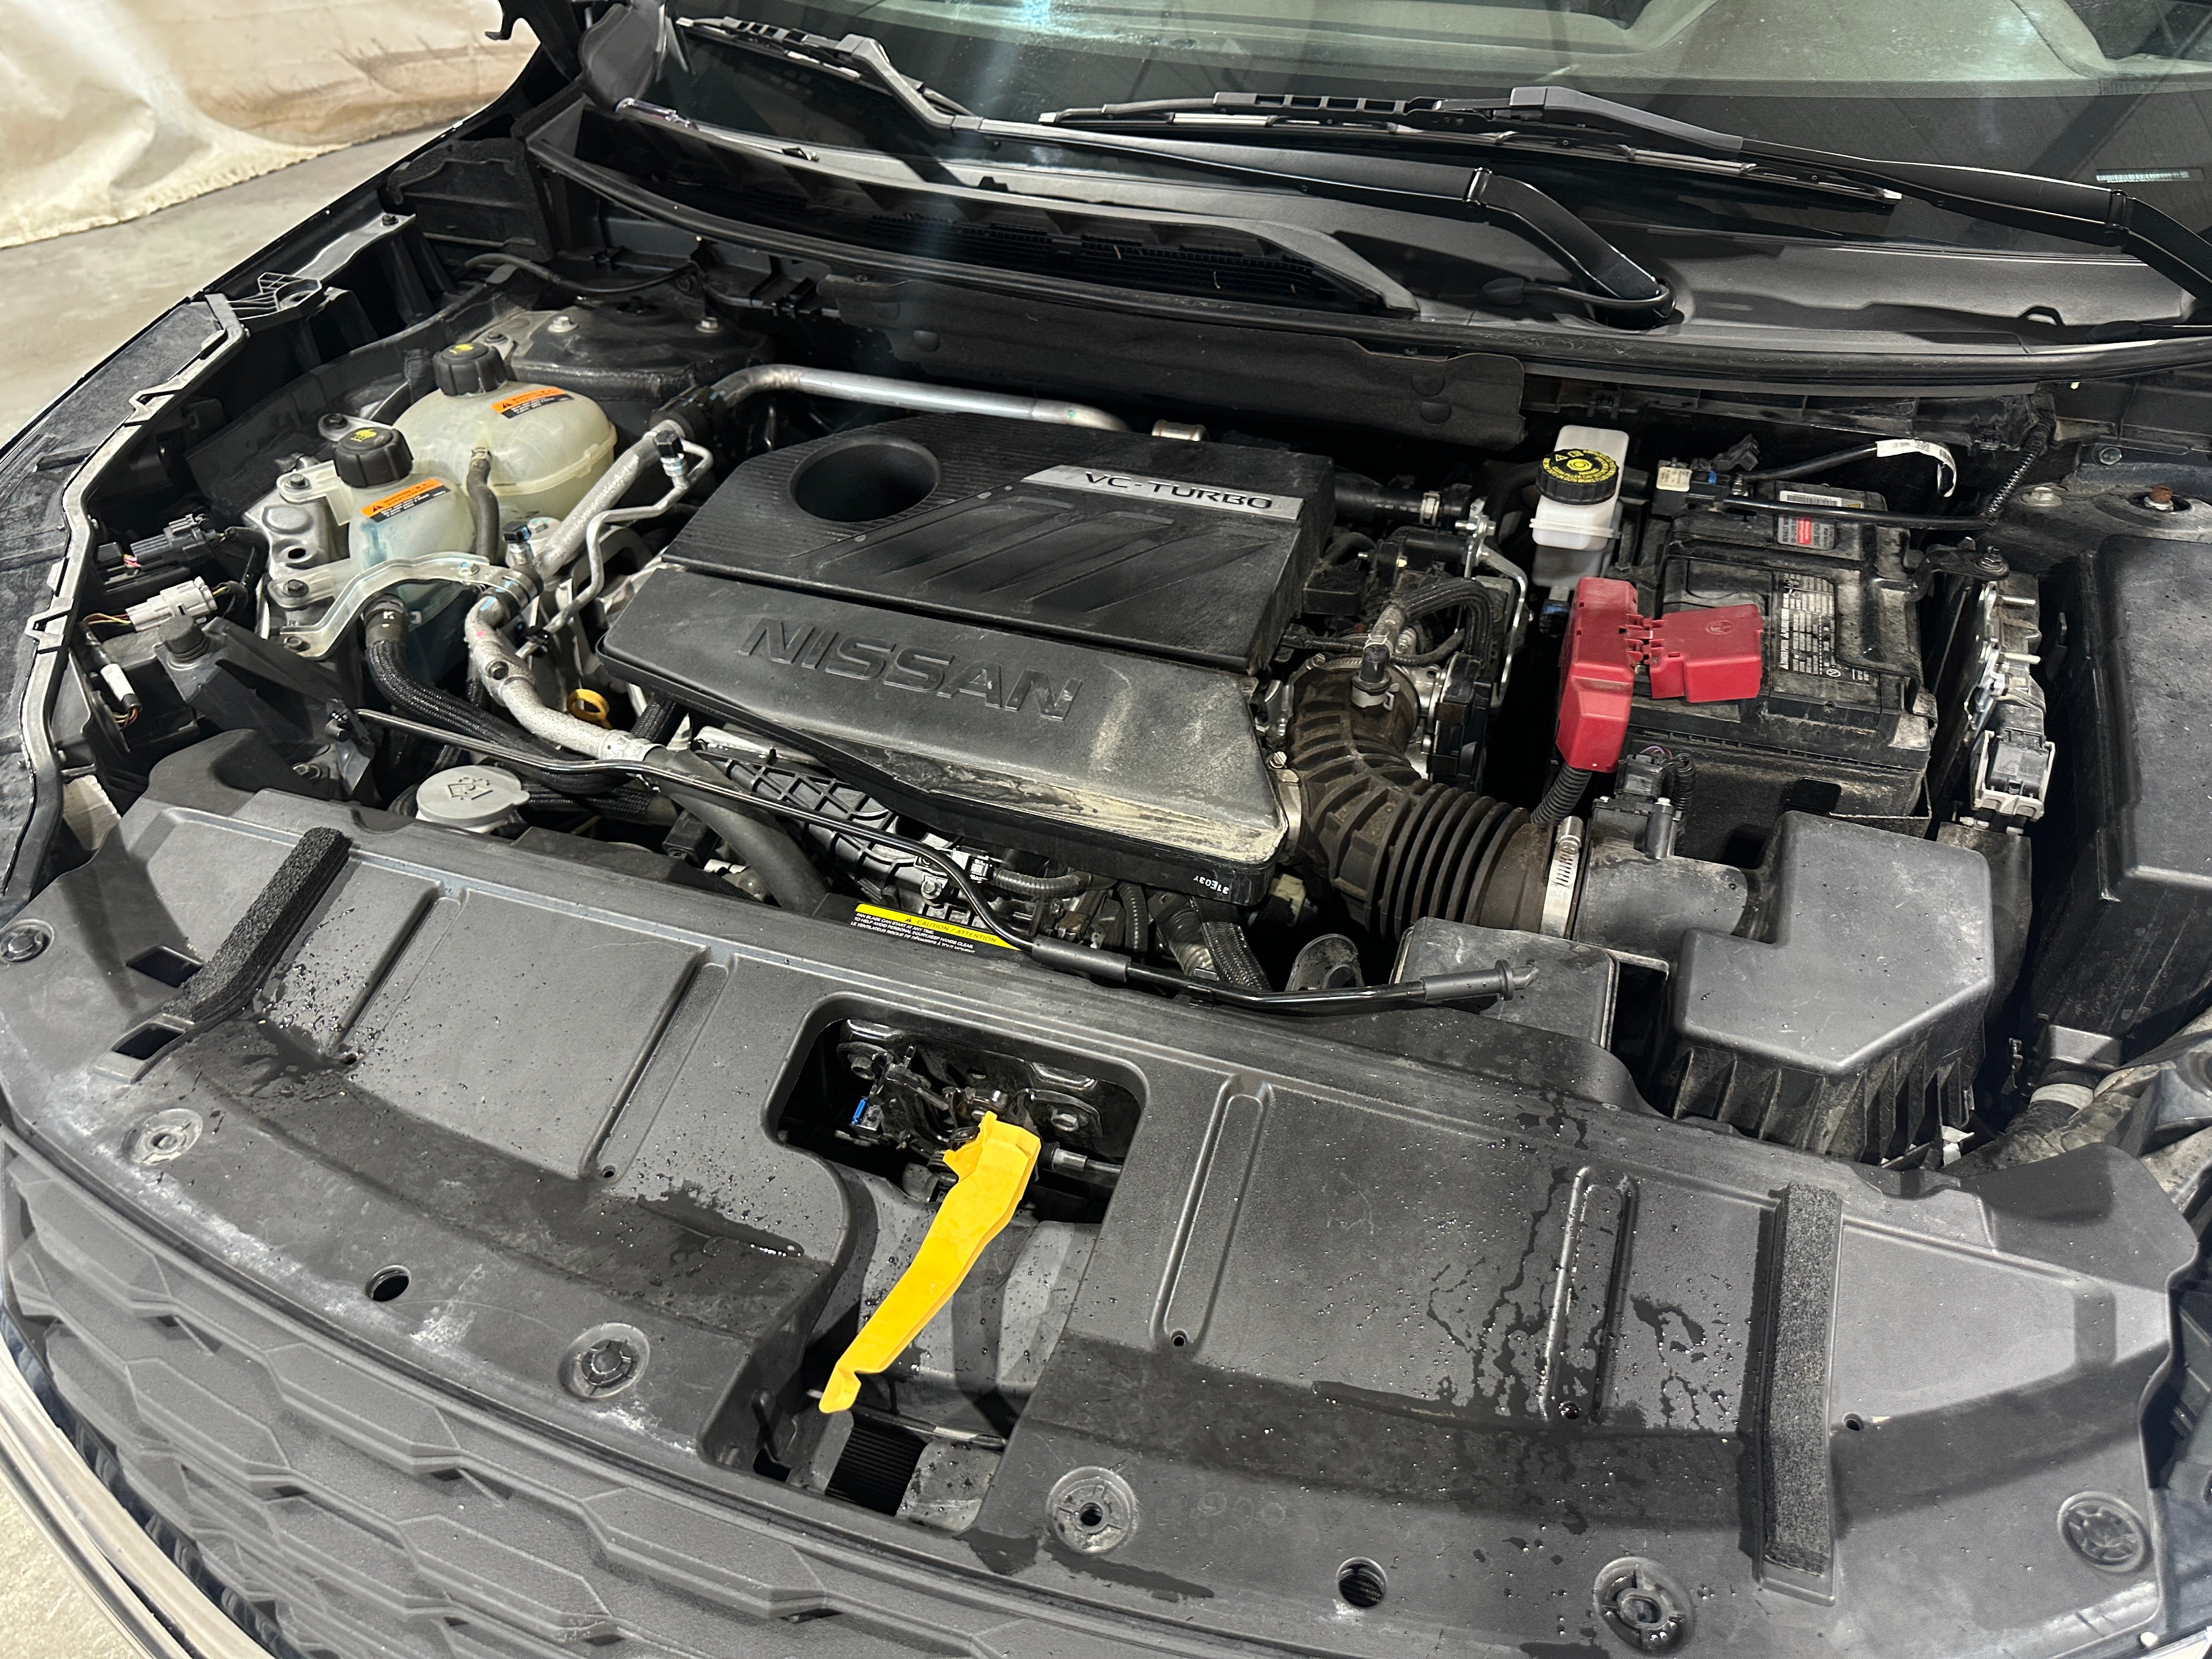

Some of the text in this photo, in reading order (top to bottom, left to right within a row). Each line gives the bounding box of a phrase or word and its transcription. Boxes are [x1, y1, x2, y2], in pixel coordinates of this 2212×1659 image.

[1085, 471, 1273, 510] VC-TURBO
[383, 611, 394, 619] K
[734, 617, 1084, 721] NISSAN
[857, 923, 887, 932] VENTILATEUR
[887, 924, 912, 934] PERSONAL
[917, 920, 950, 932] CAUTION
[956, 929, 997, 943] ATTENTION
